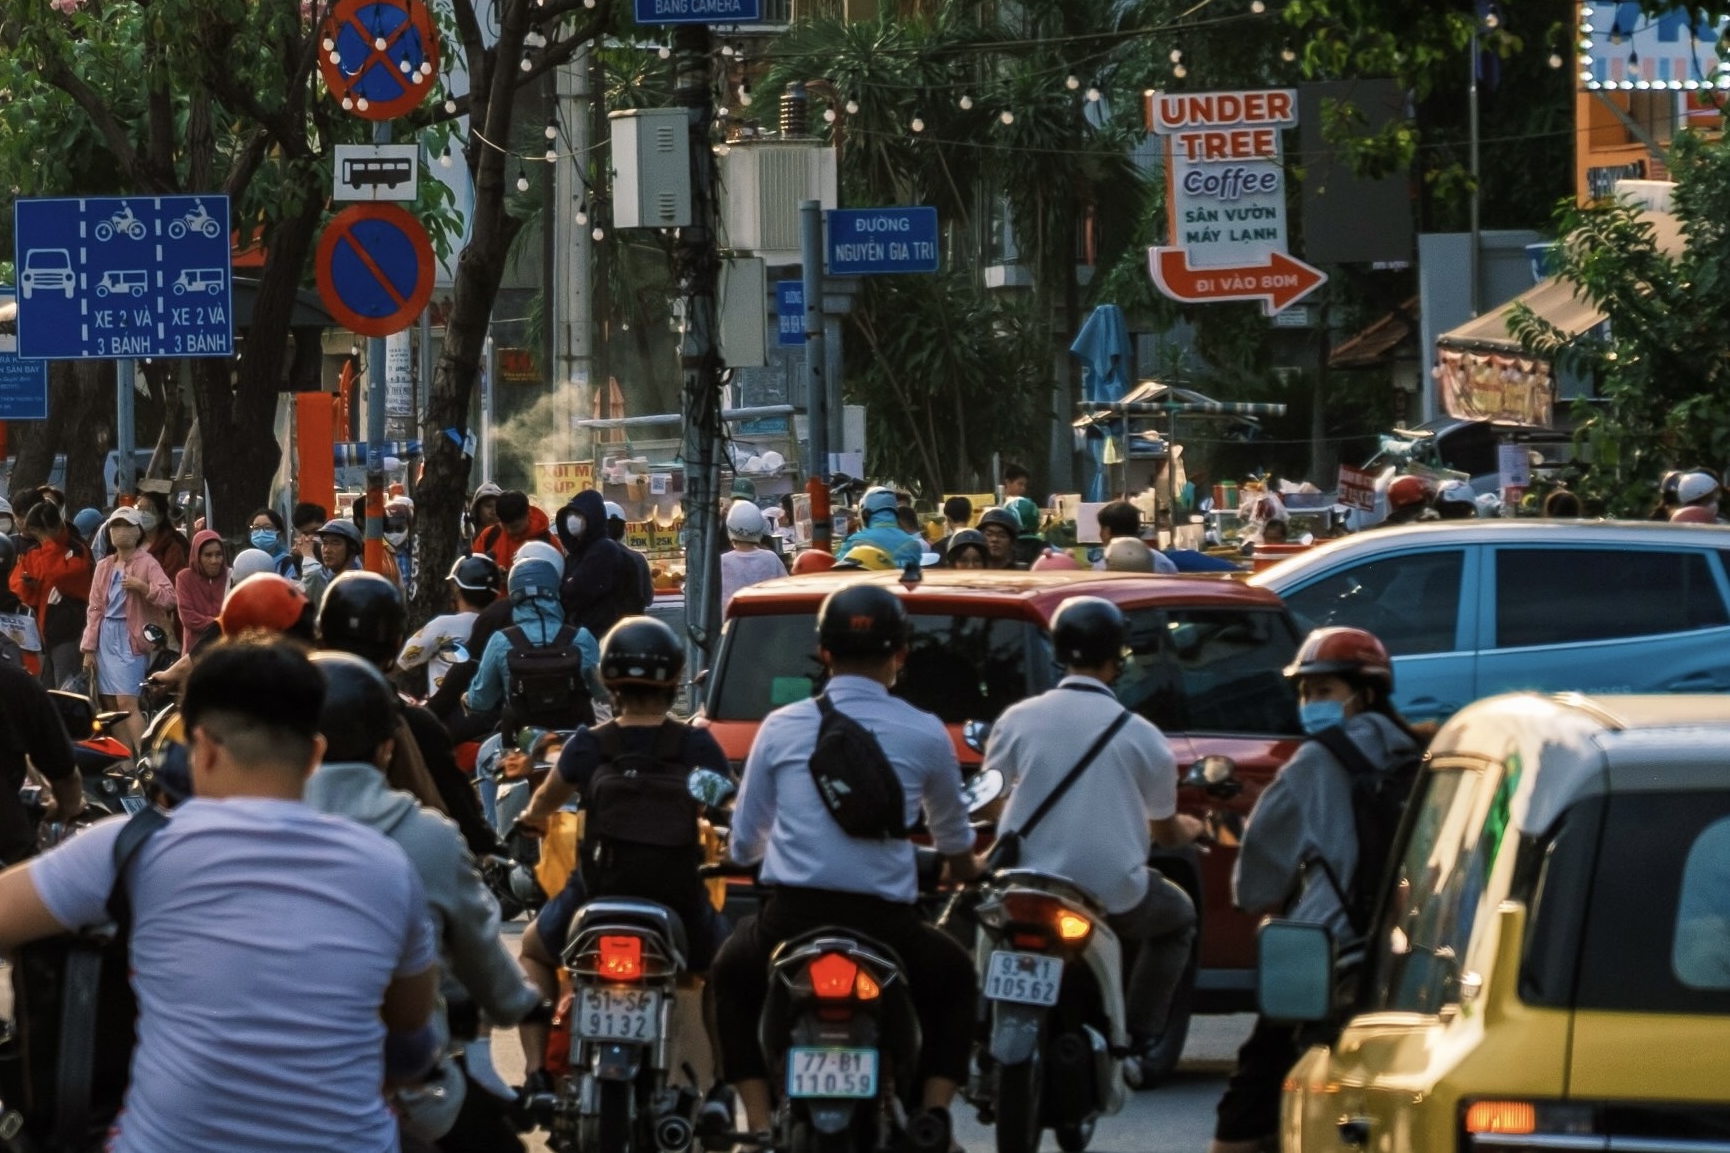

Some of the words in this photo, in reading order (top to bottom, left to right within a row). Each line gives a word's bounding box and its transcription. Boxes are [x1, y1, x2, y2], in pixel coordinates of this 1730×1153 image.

[1160, 91, 1293, 125] UNDER
[1180, 129, 1276, 161] TREE
[1184, 167, 1276, 197] Coffee
[1185, 206, 1219, 223] SÂN
[1224, 203, 1277, 222] VƯỜN
[1186, 226, 1221, 244] MÁY
[1229, 227, 1278, 245] LẠNH
[889, 242, 910, 260] GIA
[94, 310, 113, 328] XE
[119, 309, 128, 328] 2
[133, 304, 153, 327] VÀ
[172, 308, 191, 326] XE
[196, 307, 204, 325] 2
[207, 302, 226, 325] VÀ
[97, 337, 105, 355] 3
[111, 331, 151, 354] BÁNH
[174, 335, 182, 353] 3
[187, 329, 226, 352] BÁNH
